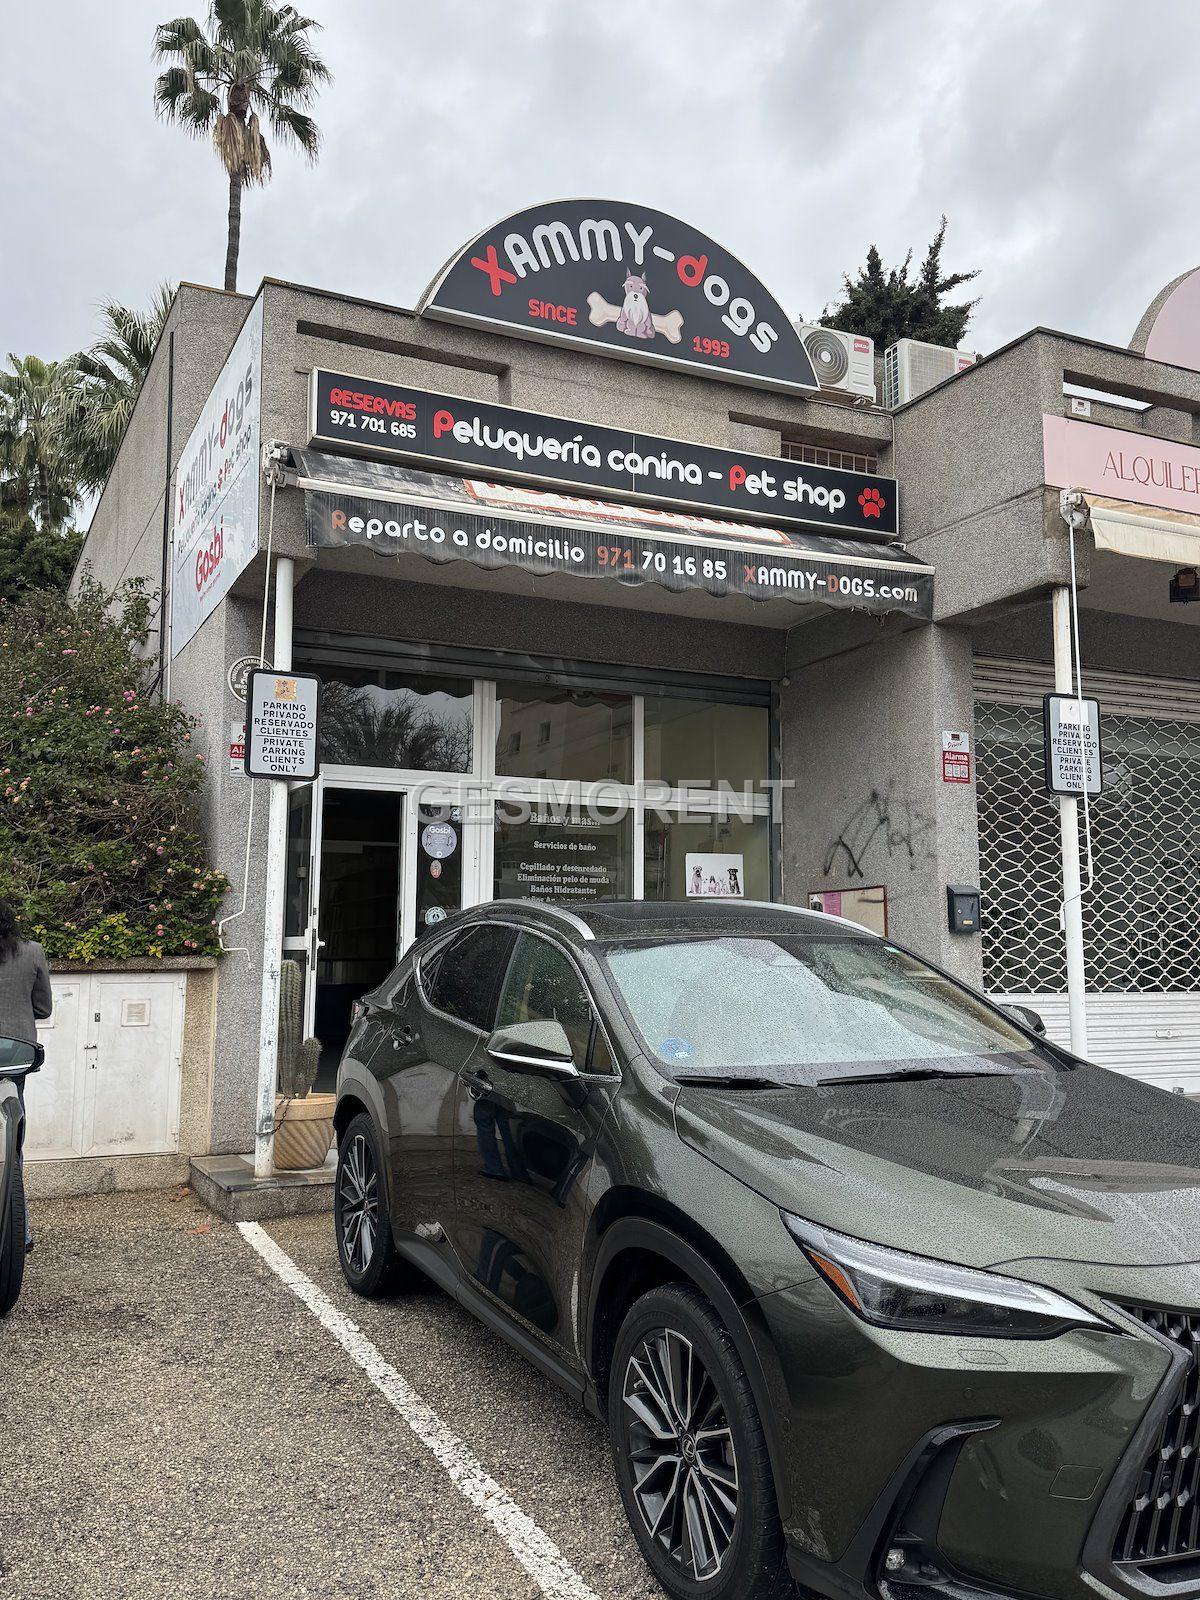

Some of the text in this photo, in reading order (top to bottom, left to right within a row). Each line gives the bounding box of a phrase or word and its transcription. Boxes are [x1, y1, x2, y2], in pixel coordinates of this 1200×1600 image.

[528, 298, 578, 326] SINCE
[692, 336, 730, 358] 1993
[330, 387, 417, 420] RESERVAS
[330, 409, 417, 438] 971 701 685
[433, 409, 601, 468] Peluquería
[607, 449, 703, 486] canina
[729, 464, 778, 498] Pet
[783, 476, 846, 513] shop
[331, 509, 446, 544] Reparto
[453, 530, 469, 547] a
[476, 529, 586, 563] domicilio
[596, 546, 635, 569] 971
[641, 551, 666, 572] 70
[672, 554, 697, 576] 16
[703, 559, 727, 580] 85
[195, 513, 224, 592] Gosbi
[263, 701, 307, 712] PARKING
[263, 710, 306, 720] PRIVADO
[254, 718, 314, 729] RESERVADO
[260, 727, 308, 737] CLIENTES
[1059, 731, 1091, 740] PRIVAO
[263, 738, 304, 748] PRIVATE
[262, 747, 306, 756] PARKING
[945, 752, 968, 761] Alarma
[262, 755, 305, 765] CLIENTS
[1060, 756, 1091, 766] PRIVAE
[270, 764, 297, 773] ONLY
[1060, 772, 1092, 782] CLIENS
[530, 812, 561, 824] Baños
[561, 816, 570, 827] y
[428, 826, 451, 834] Gosbi
[534, 841, 567, 850] Servicios
[579, 843, 597, 851] baño
[520, 862, 607, 873] Cepillado y desenredado
[517, 873, 561, 882] Eliminación
[562, 876, 578, 884] pelo
[589, 876, 610, 884] muda
[530, 885, 597, 895] Baños Hidratantes
